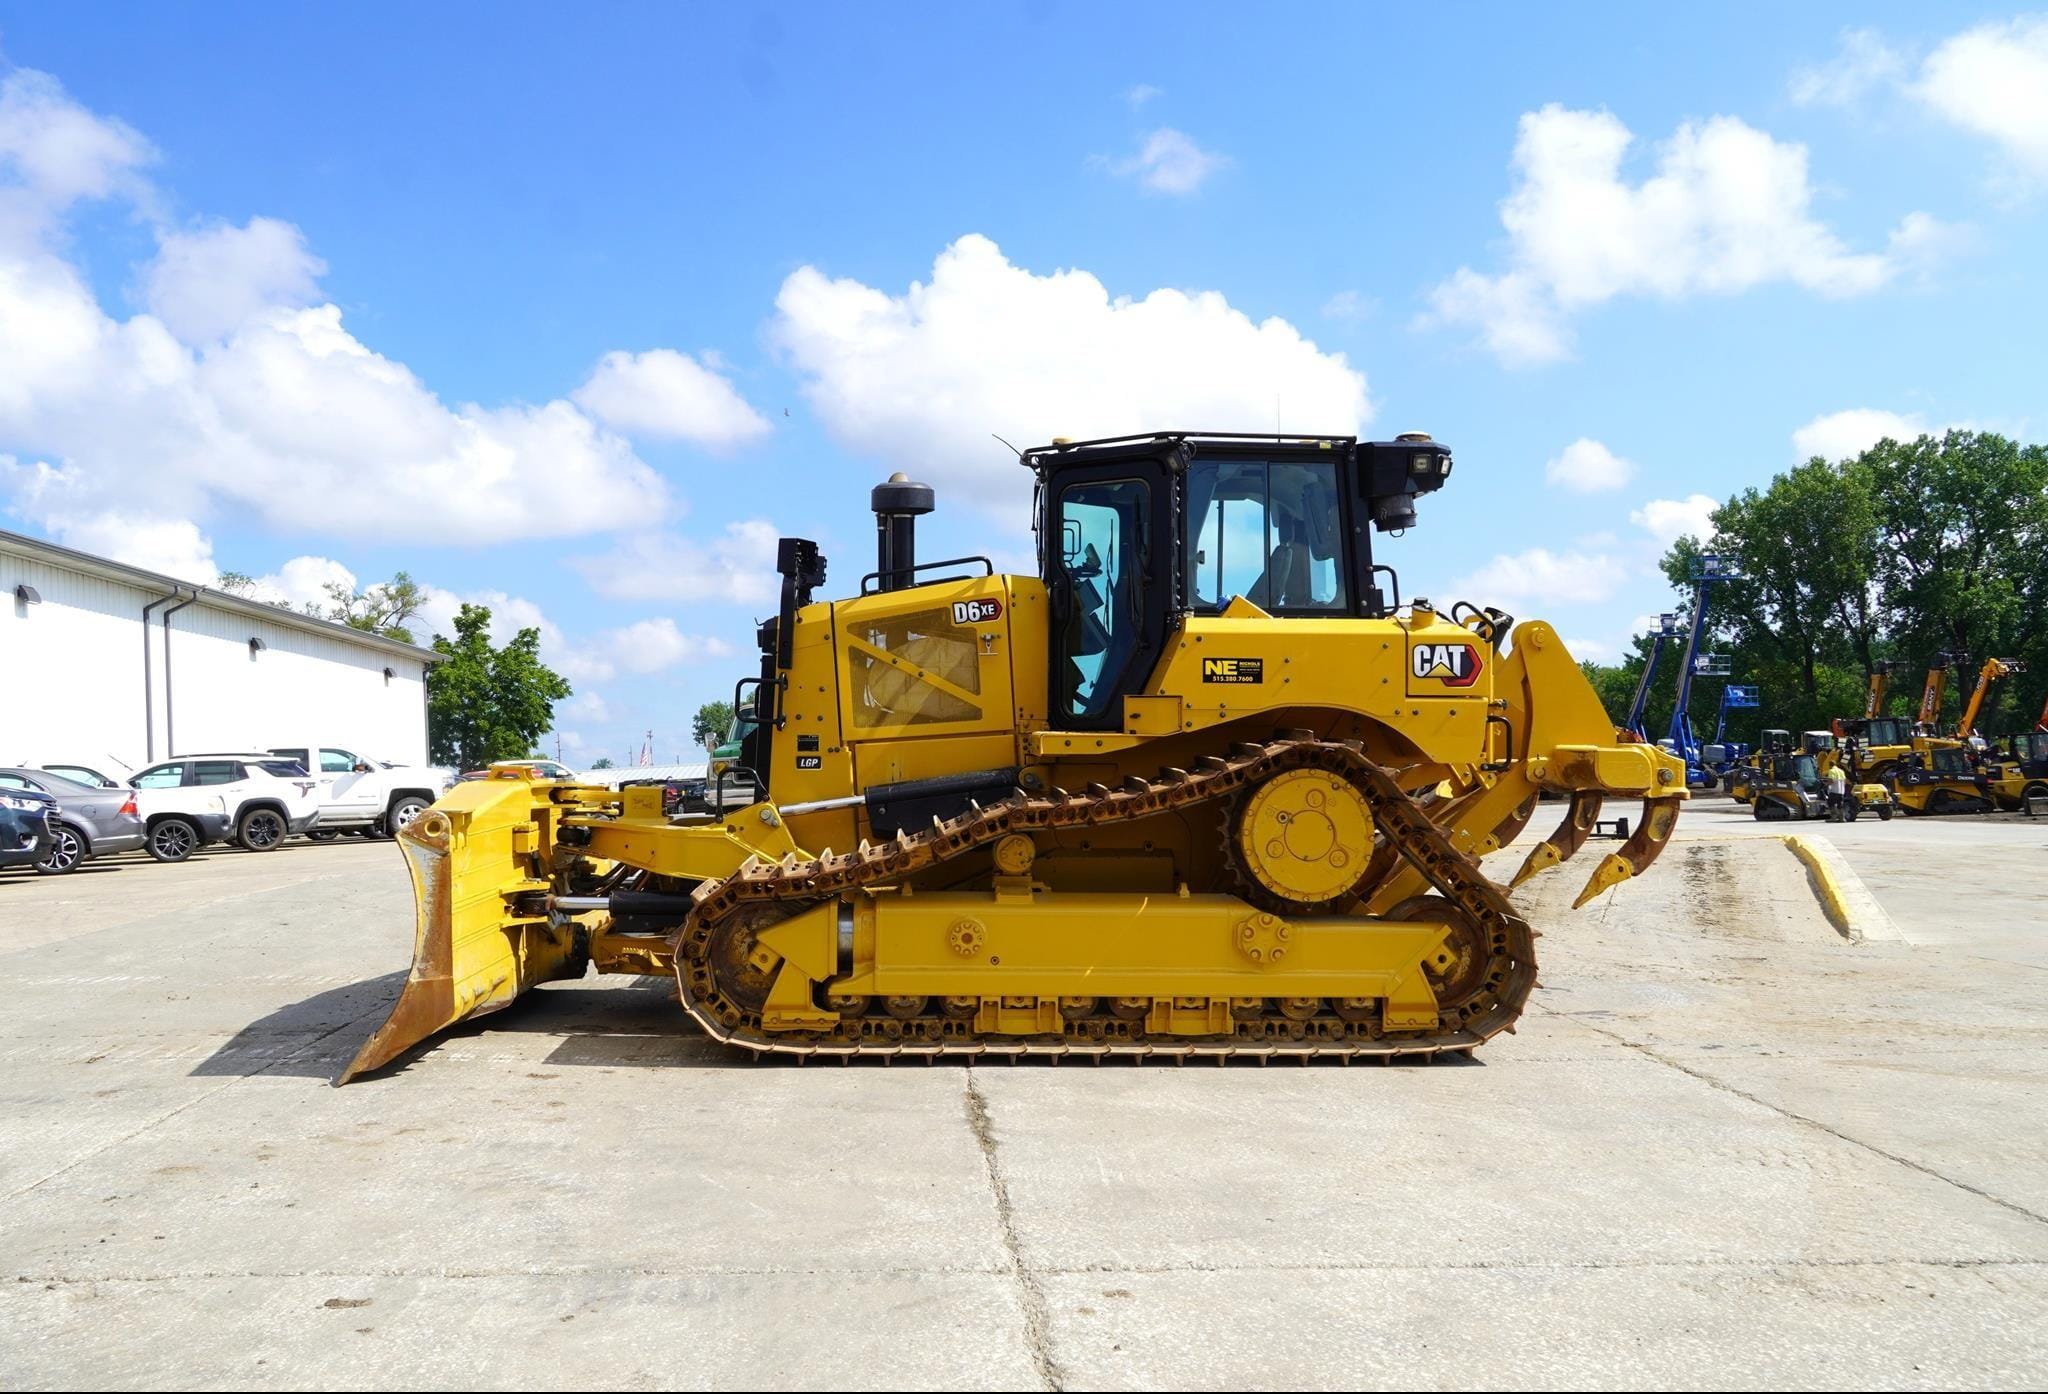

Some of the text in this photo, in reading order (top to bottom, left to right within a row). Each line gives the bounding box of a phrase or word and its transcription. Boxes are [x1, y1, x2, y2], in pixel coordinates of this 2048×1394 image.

[1205, 660, 1238, 675] NE
[1413, 645, 1465, 677] CAT
[800, 758, 819, 767] LGP
